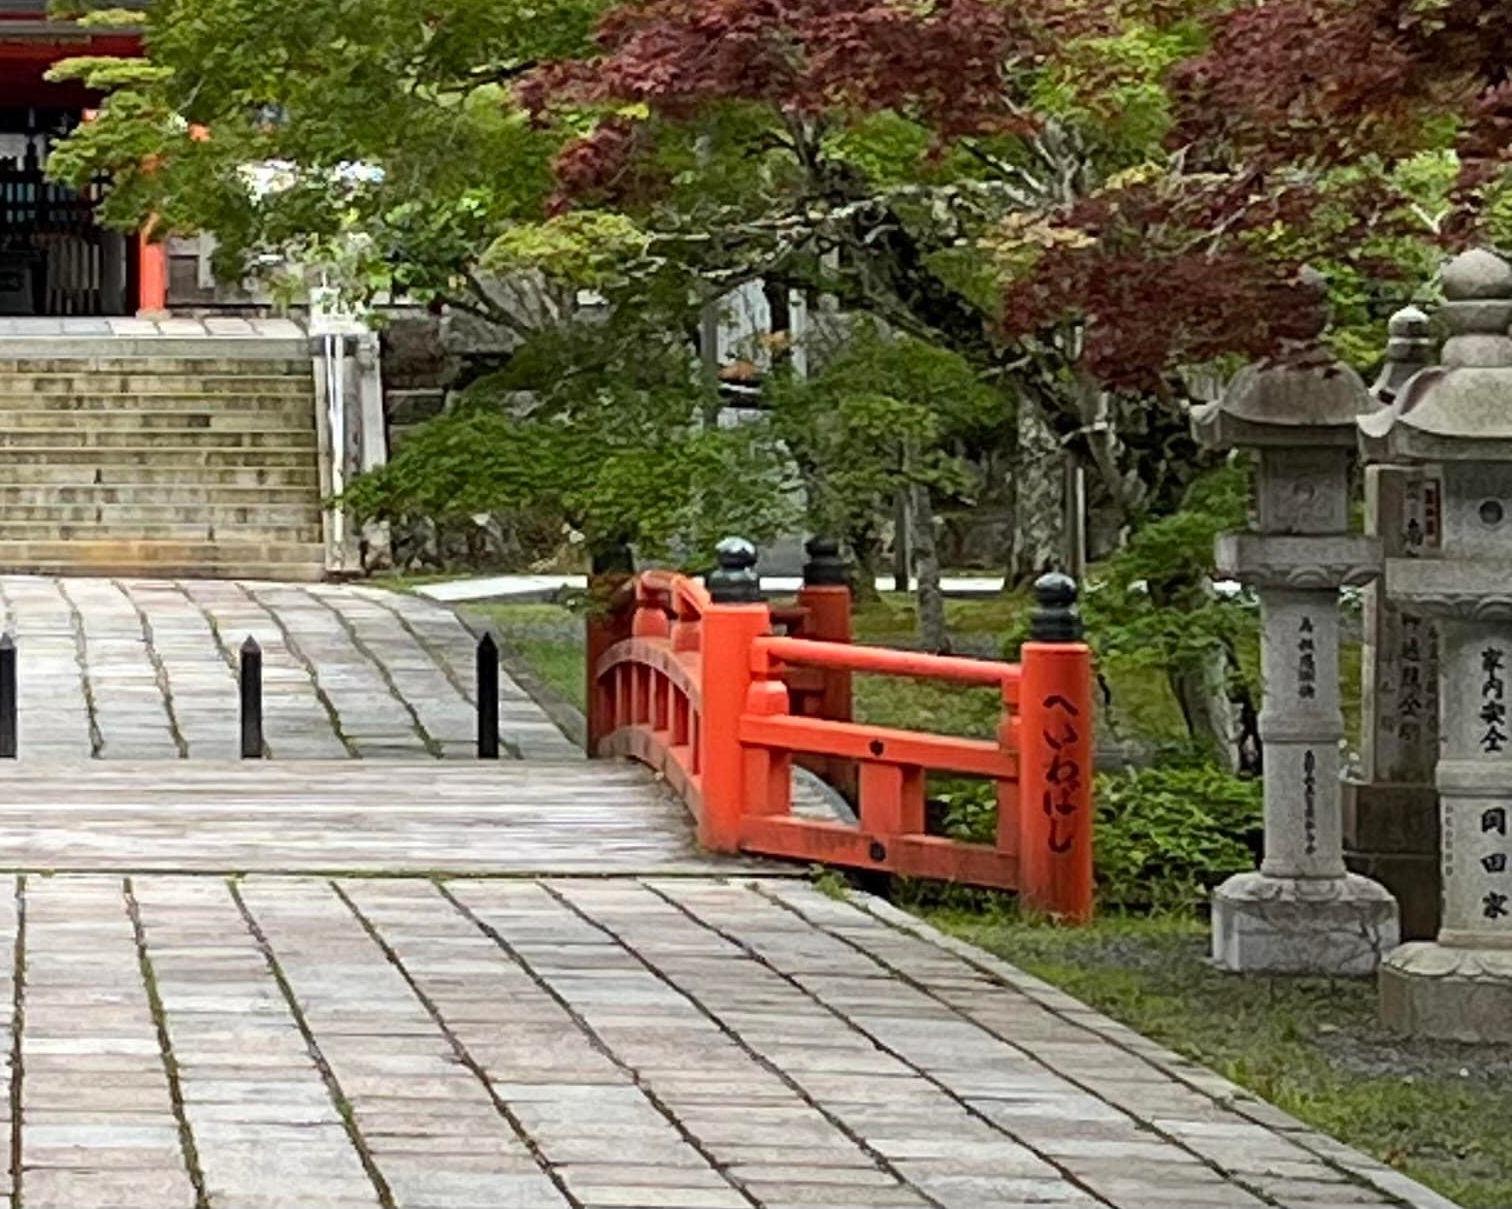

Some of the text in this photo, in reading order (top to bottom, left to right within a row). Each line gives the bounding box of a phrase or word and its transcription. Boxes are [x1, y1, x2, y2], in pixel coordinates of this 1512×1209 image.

[1479, 646, 1508, 754] 家内安全
[1042, 694, 1080, 853] へいわばし
[1480, 806, 1509, 919] 岡田家
